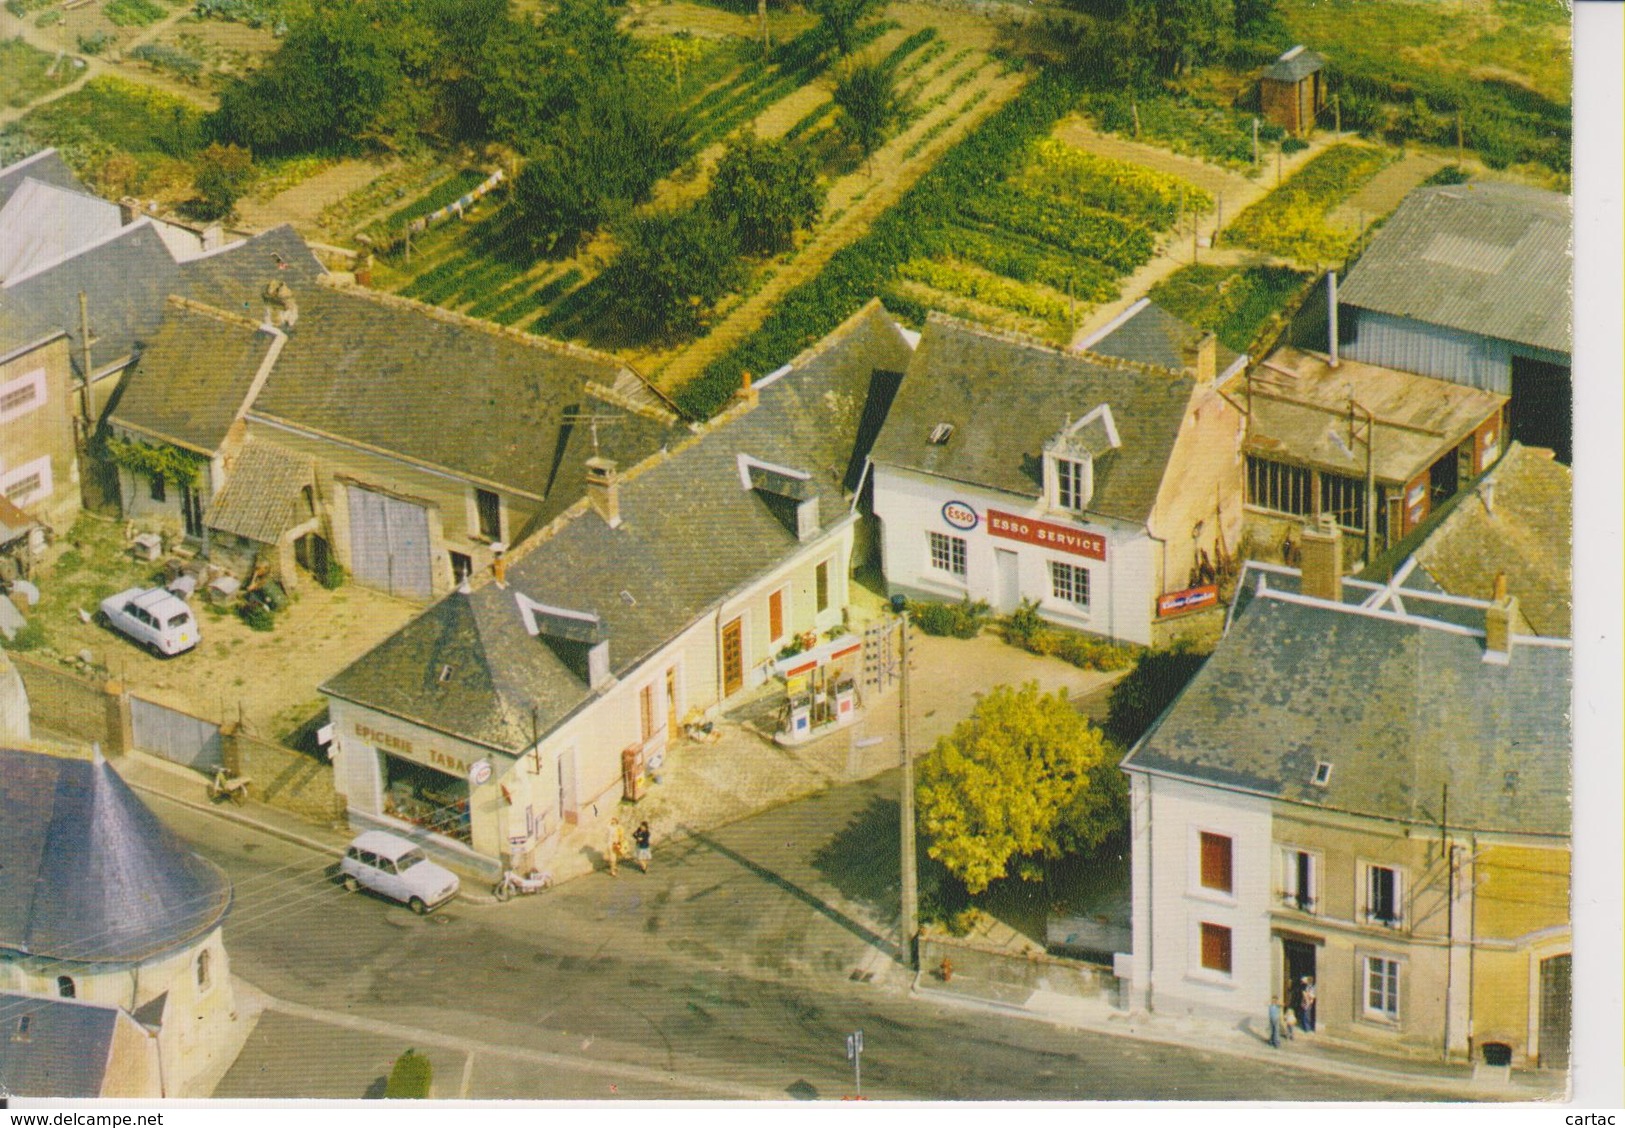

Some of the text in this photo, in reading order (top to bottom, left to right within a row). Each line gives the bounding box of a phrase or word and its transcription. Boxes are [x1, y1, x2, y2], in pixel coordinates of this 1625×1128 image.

[992, 518, 1101, 552] ESSO SERVICE
[354, 723, 413, 754] EPICERIE
